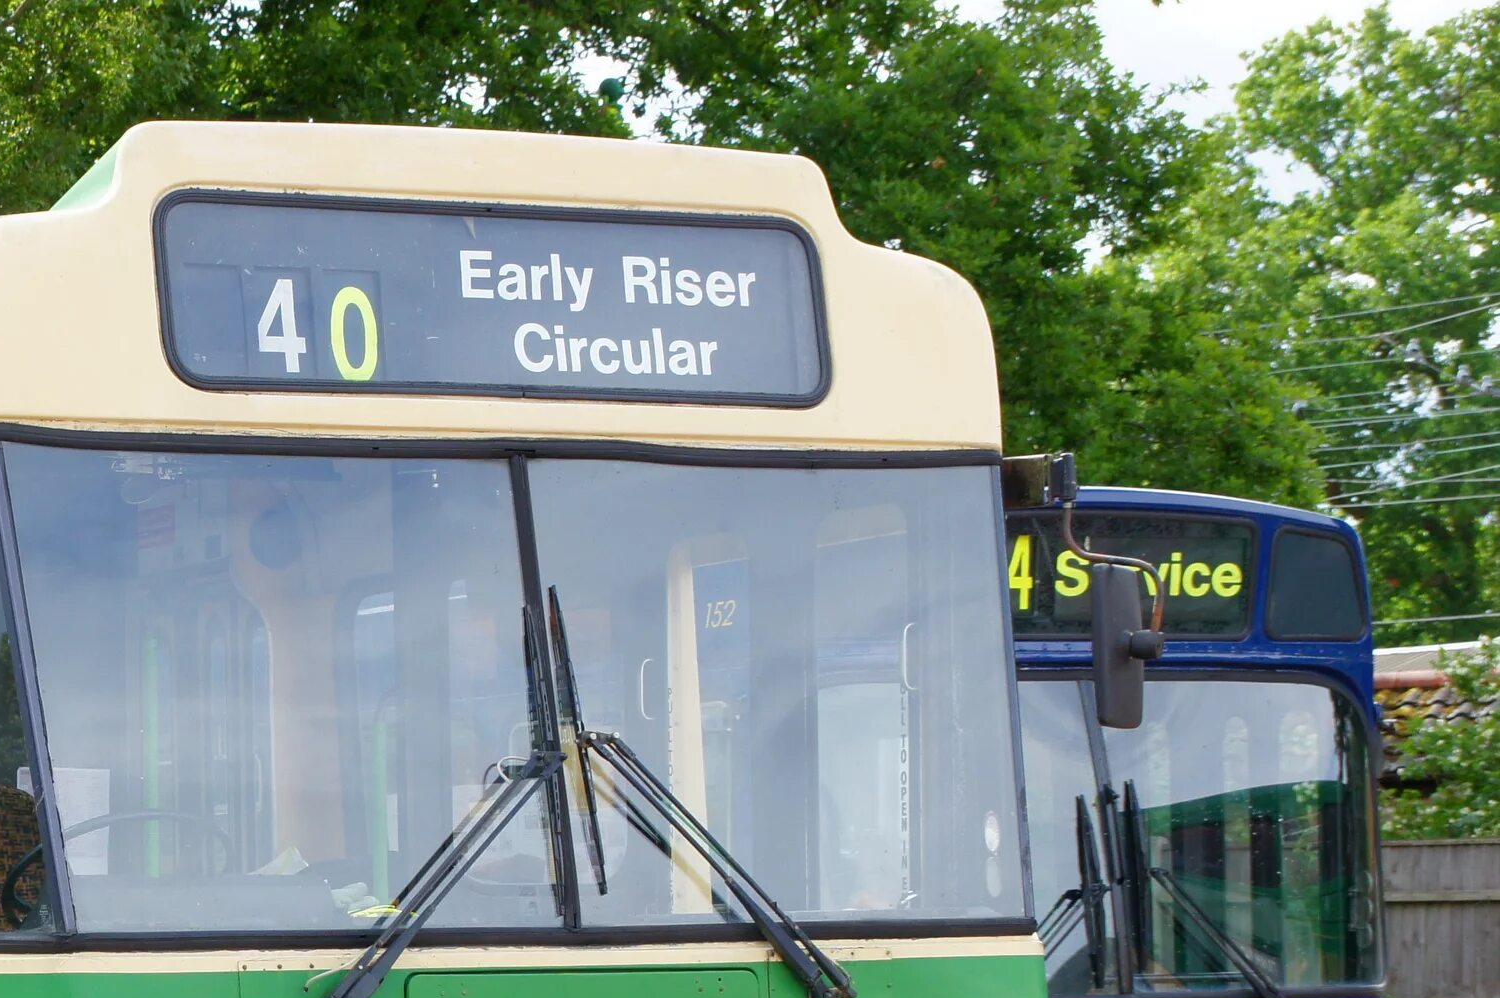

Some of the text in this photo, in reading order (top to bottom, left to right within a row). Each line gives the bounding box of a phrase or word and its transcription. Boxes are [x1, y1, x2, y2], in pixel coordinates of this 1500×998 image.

[459, 249, 756, 312] Early Riser
[513, 322, 718, 376] Circular
[1008, 534, 1243, 610] 4 Svice
[705, 599, 736, 629] 152
[900, 770, 908, 832] OPEN
